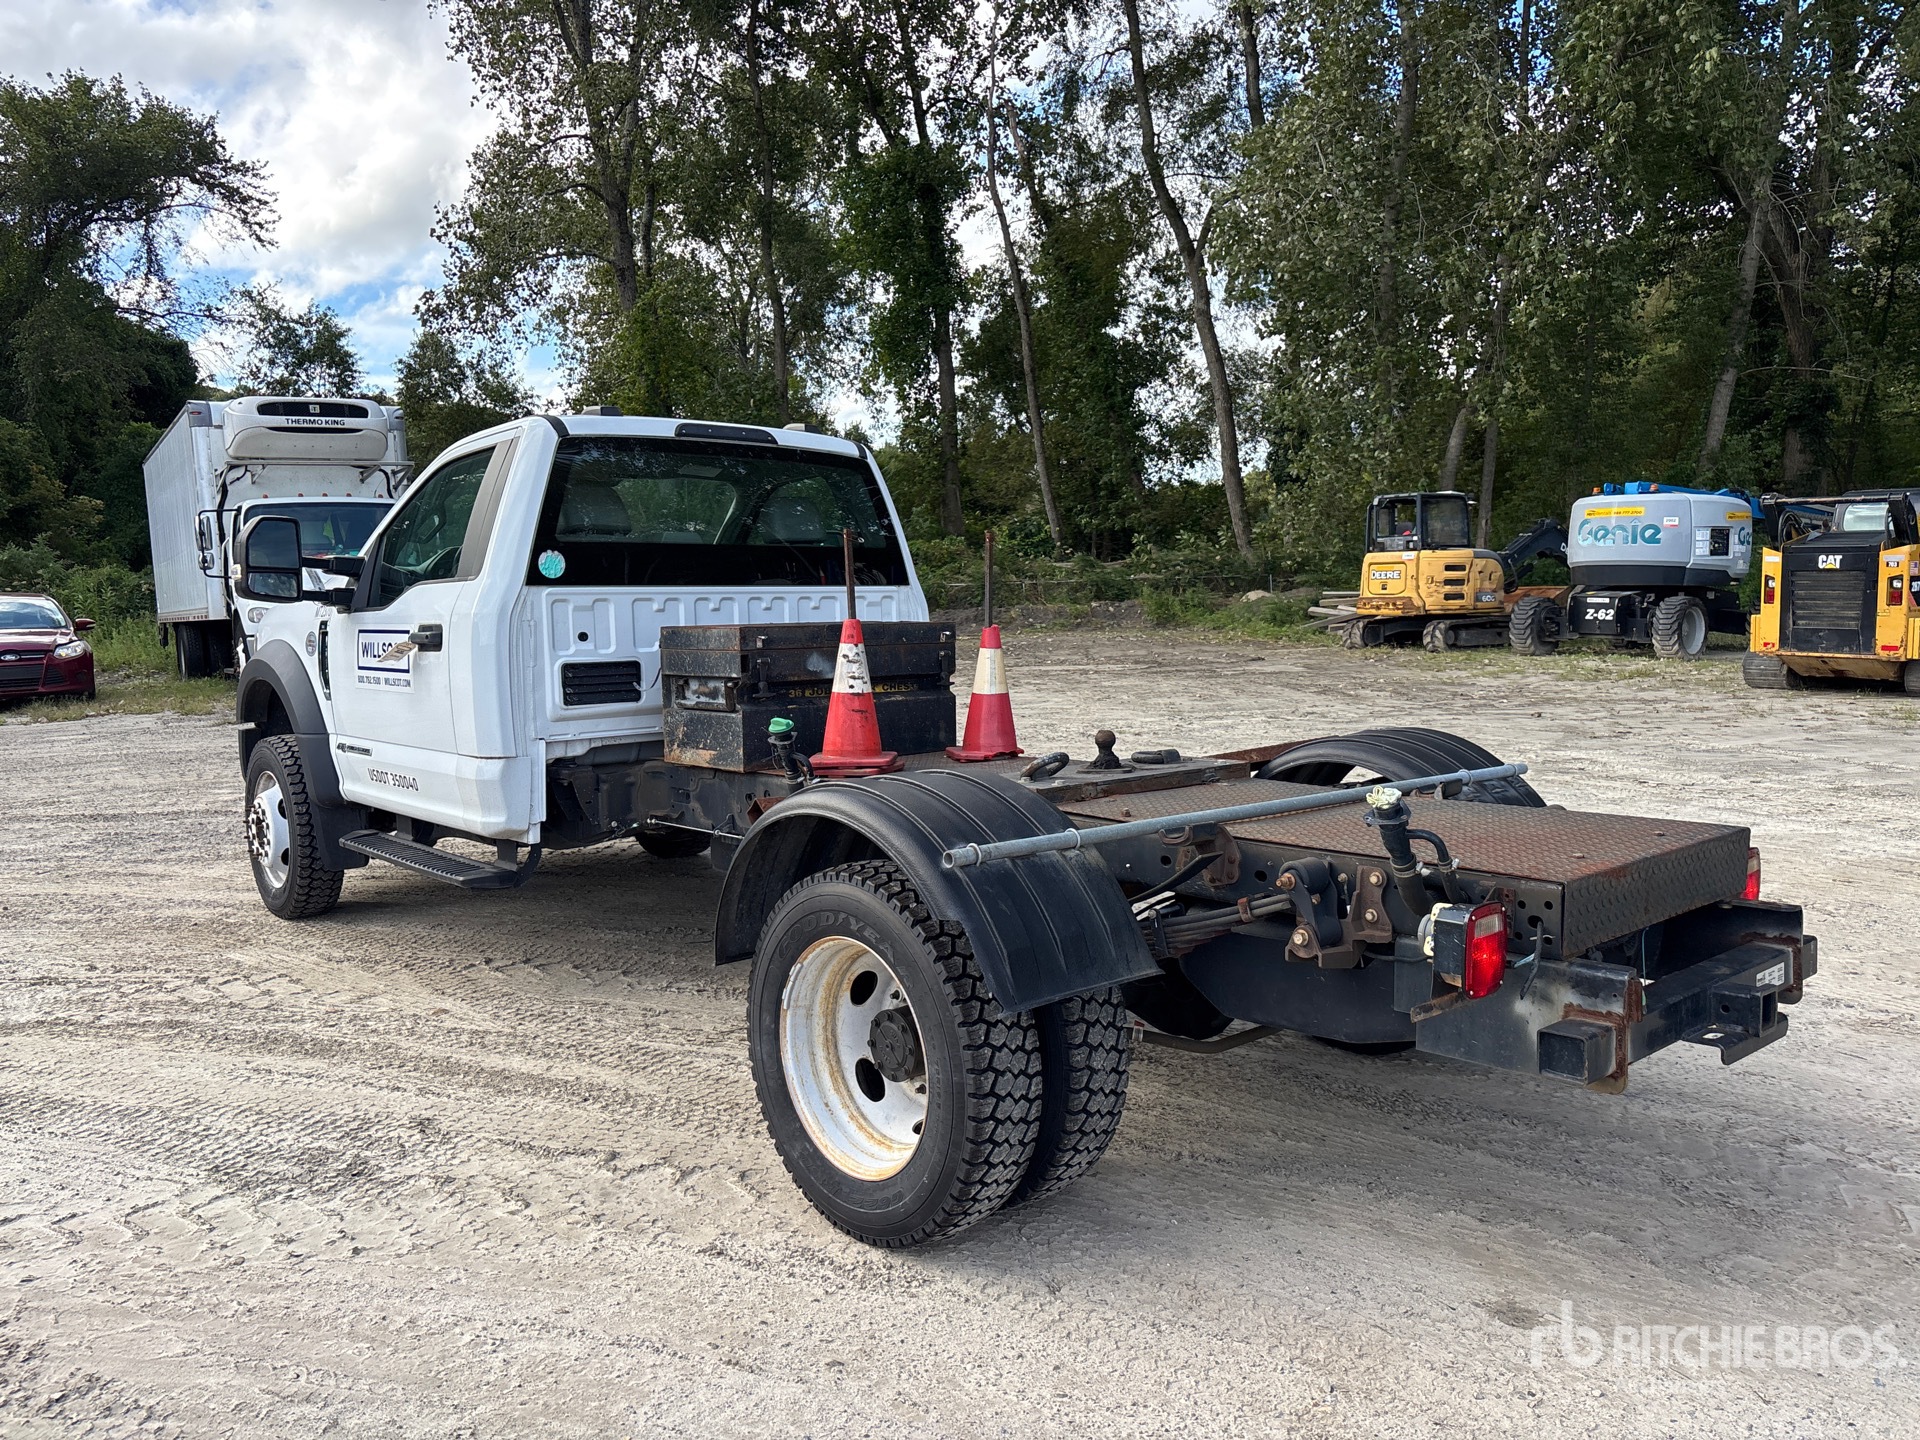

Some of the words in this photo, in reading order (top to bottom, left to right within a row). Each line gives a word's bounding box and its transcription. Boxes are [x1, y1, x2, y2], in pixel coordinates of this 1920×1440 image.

[285, 418, 323, 426] THERMO
[1577, 517, 1661, 547] Genie
[1818, 554, 1843, 569] CAT
[1371, 569, 1401, 580] DEERE
[1585, 608, 1615, 621] Z-62
[361, 641, 398, 659] WILLSC
[384, 677, 411, 688] WILLSCOT.COM
[367, 767, 390, 785] USDOT
[390, 772, 419, 792] 350040
[778, 911, 915, 989] GOODYEAR
